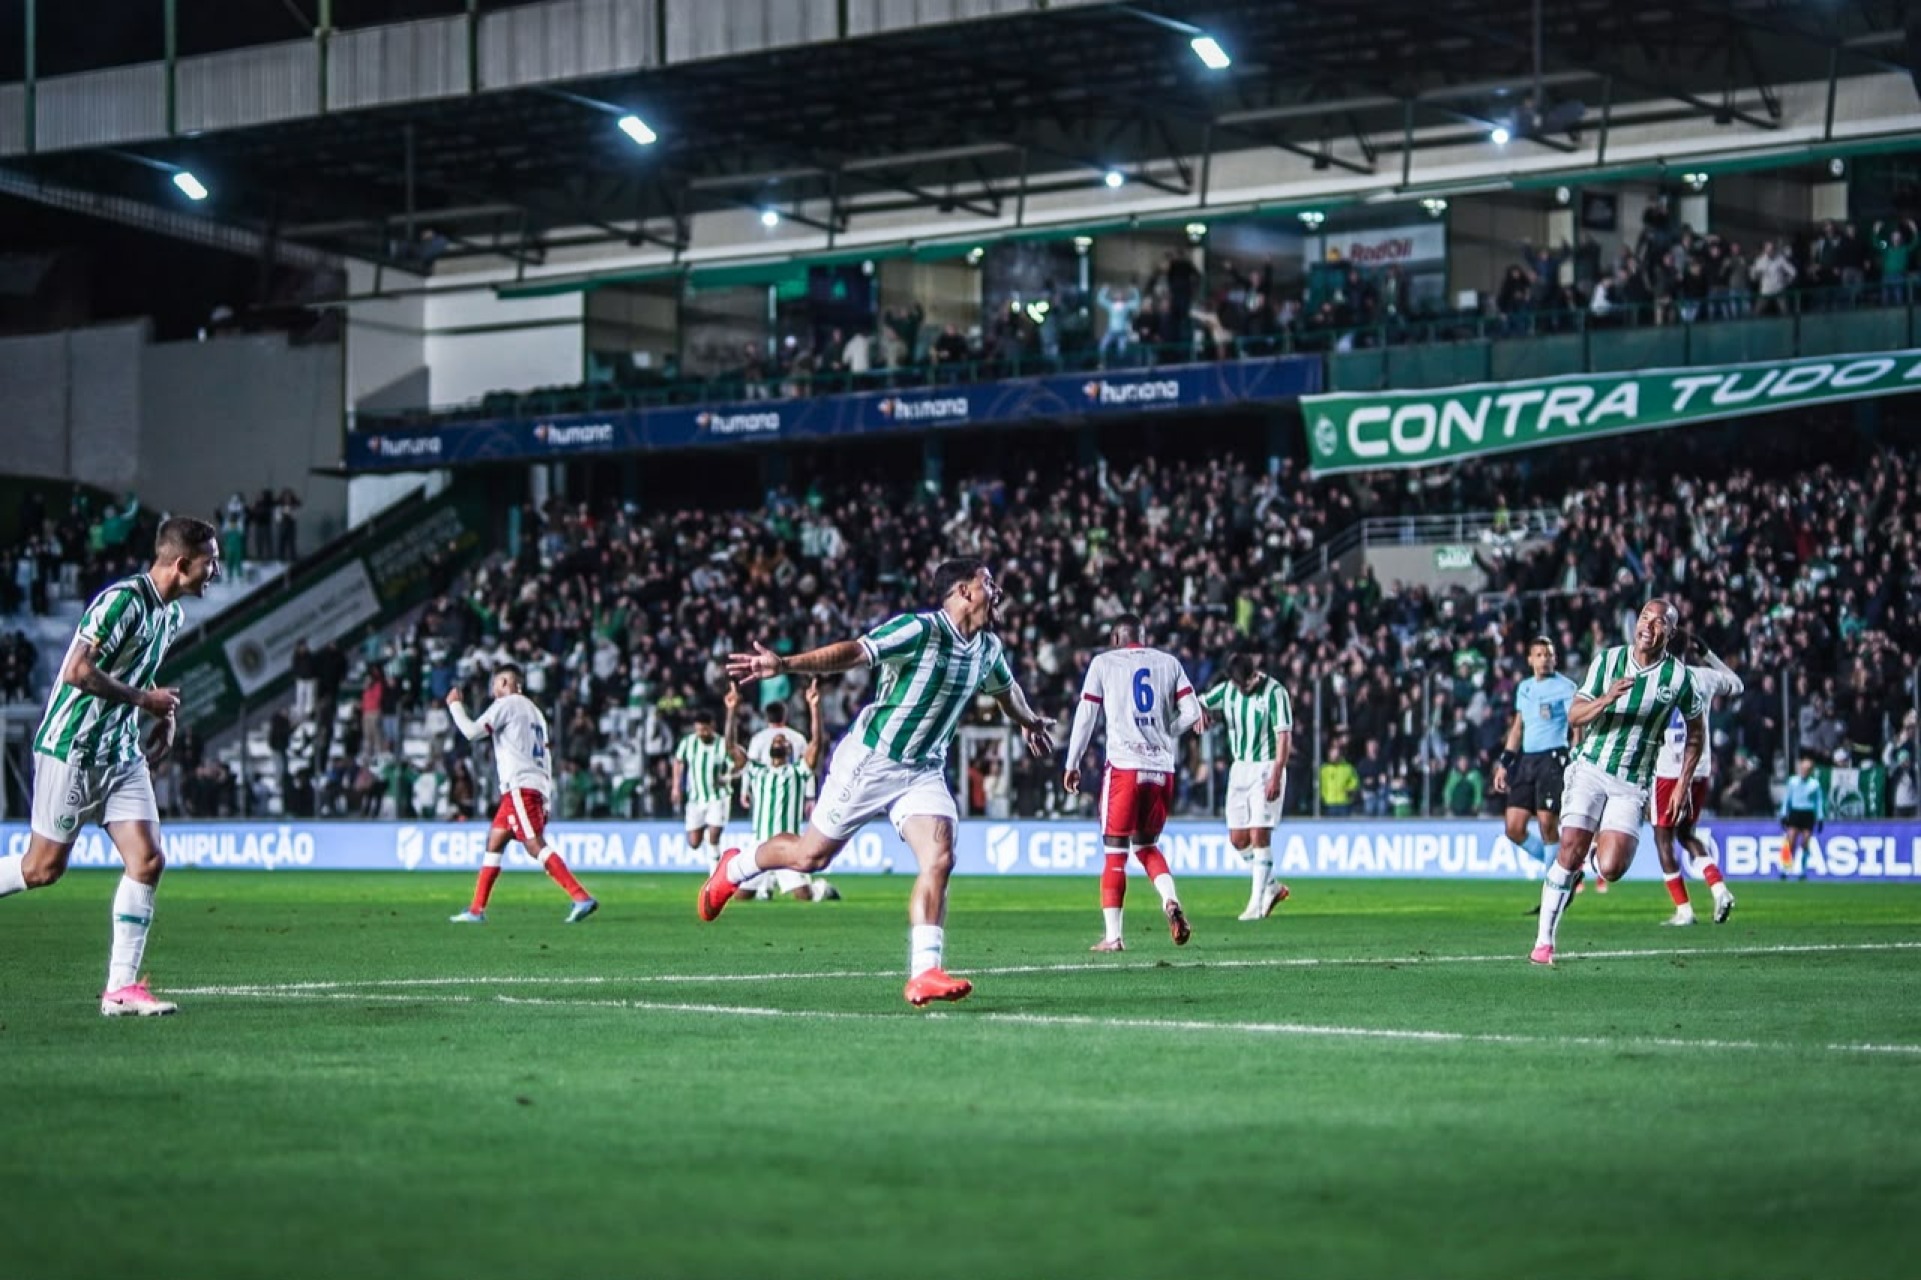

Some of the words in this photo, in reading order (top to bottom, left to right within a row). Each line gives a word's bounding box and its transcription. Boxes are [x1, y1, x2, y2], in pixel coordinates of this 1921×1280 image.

[711, 412, 780, 433] humana
[1347, 382, 1639, 457] CONTRA
[1672, 358, 1896, 412] TUDO
[1132, 667, 1155, 713] 6
[160, 825, 315, 871] NIPULAÇÃO
[430, 831, 490, 866] CBF
[631, 832, 650, 866] A
[1028, 831, 1098, 869] CBF
[1281, 833, 1310, 871] A
